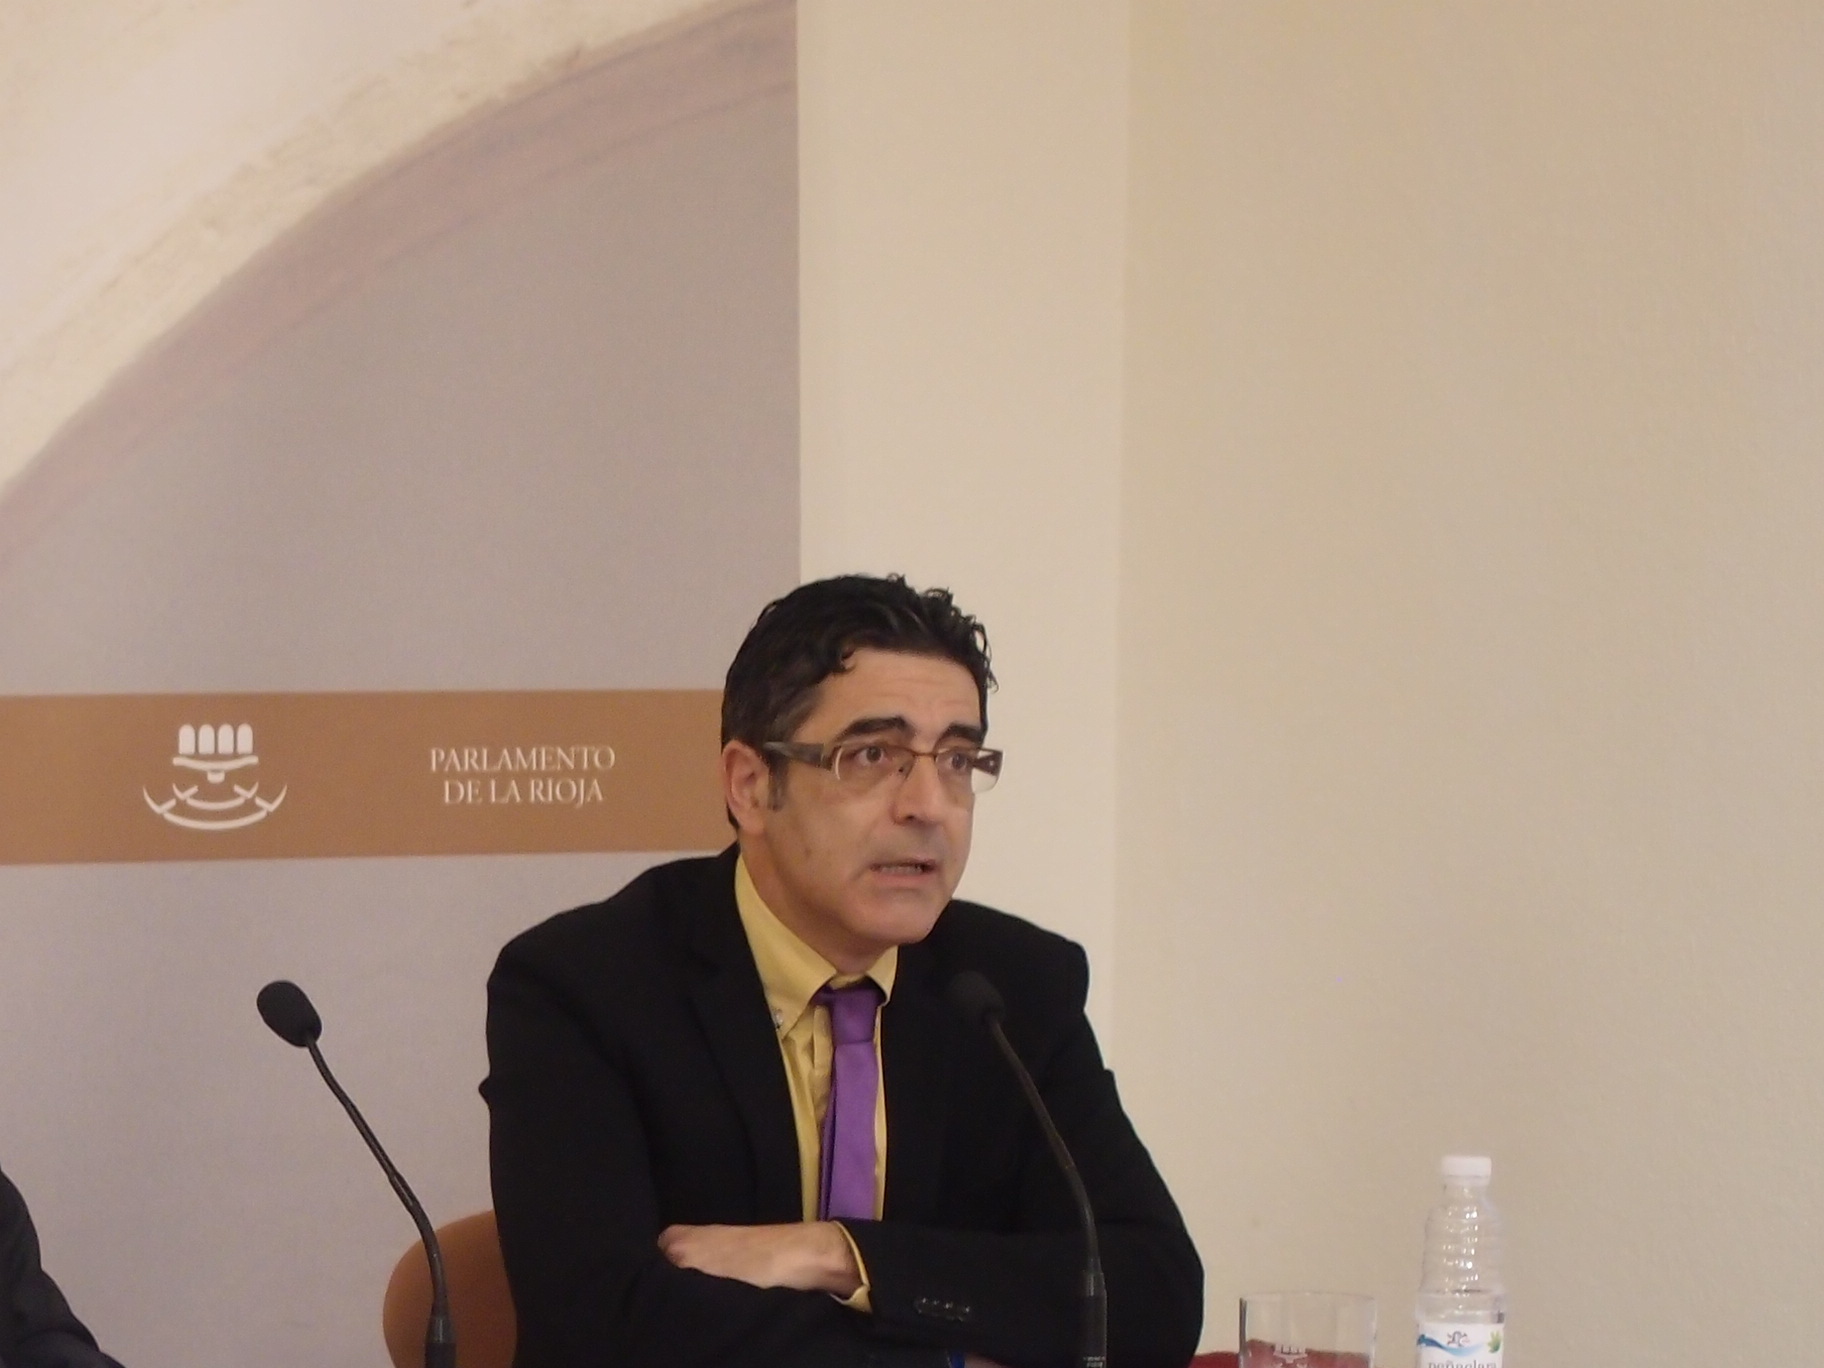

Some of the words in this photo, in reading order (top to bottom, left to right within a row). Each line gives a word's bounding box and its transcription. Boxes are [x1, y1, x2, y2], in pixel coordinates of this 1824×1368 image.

[430, 746, 616, 772] PARLAMENTO
[444, 779, 483, 804] DE
[490, 779, 521, 803] LA
[530, 777, 604, 808] RIOJA
